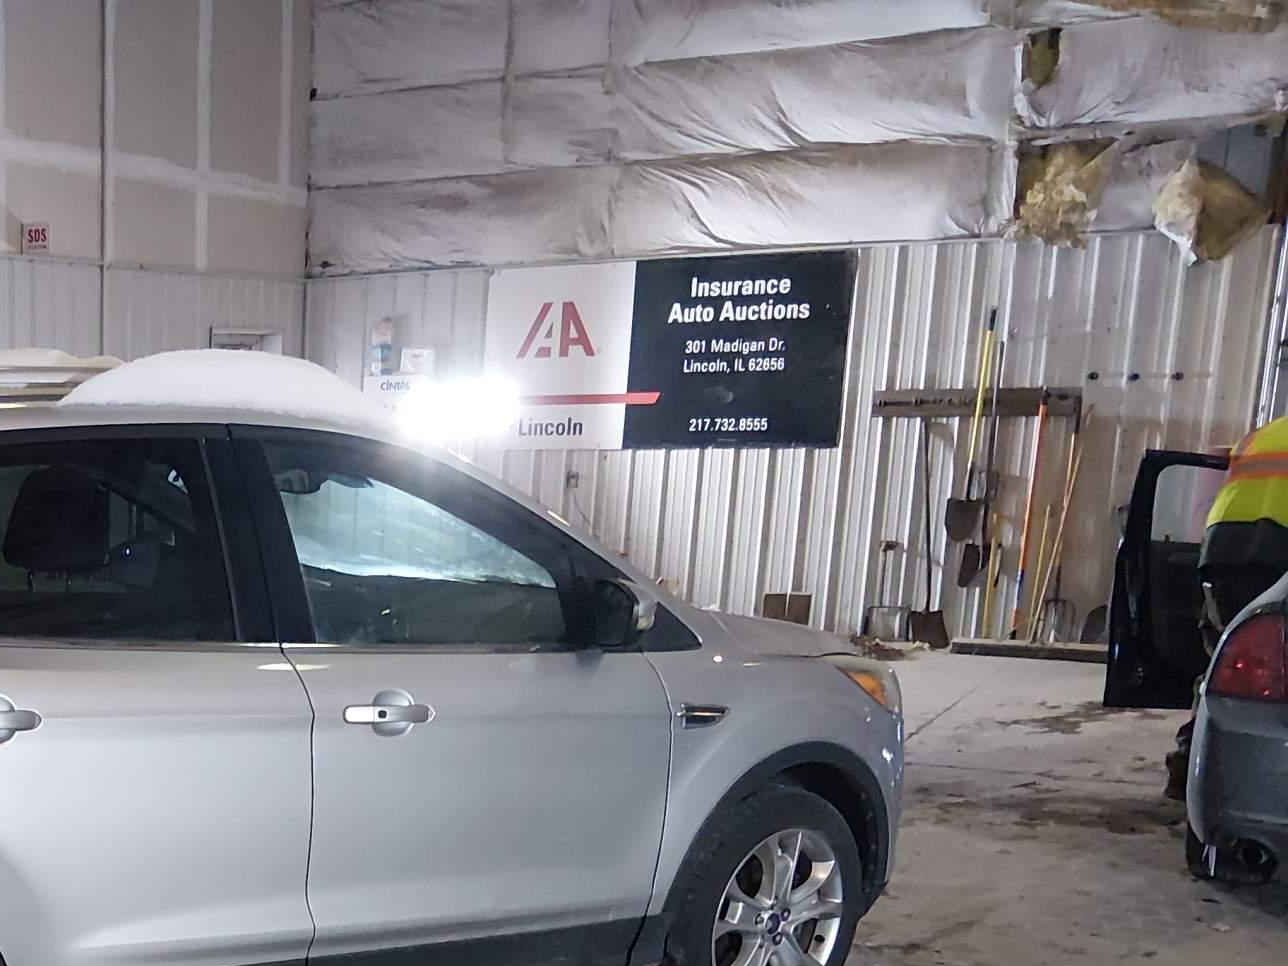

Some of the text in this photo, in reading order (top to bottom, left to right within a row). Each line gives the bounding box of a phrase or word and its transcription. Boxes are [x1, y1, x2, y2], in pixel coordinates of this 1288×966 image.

[28, 228, 47, 243] SDS
[691, 277, 791, 298] Insurance
[668, 299, 810, 323] Auto Auctions
[685, 337, 786, 354] 301 Madigan Dr.
[683, 357, 785, 374] Lincoln, IL 62656
[518, 417, 583, 436] Lincoln
[689, 418, 768, 431] 217.732.8555
